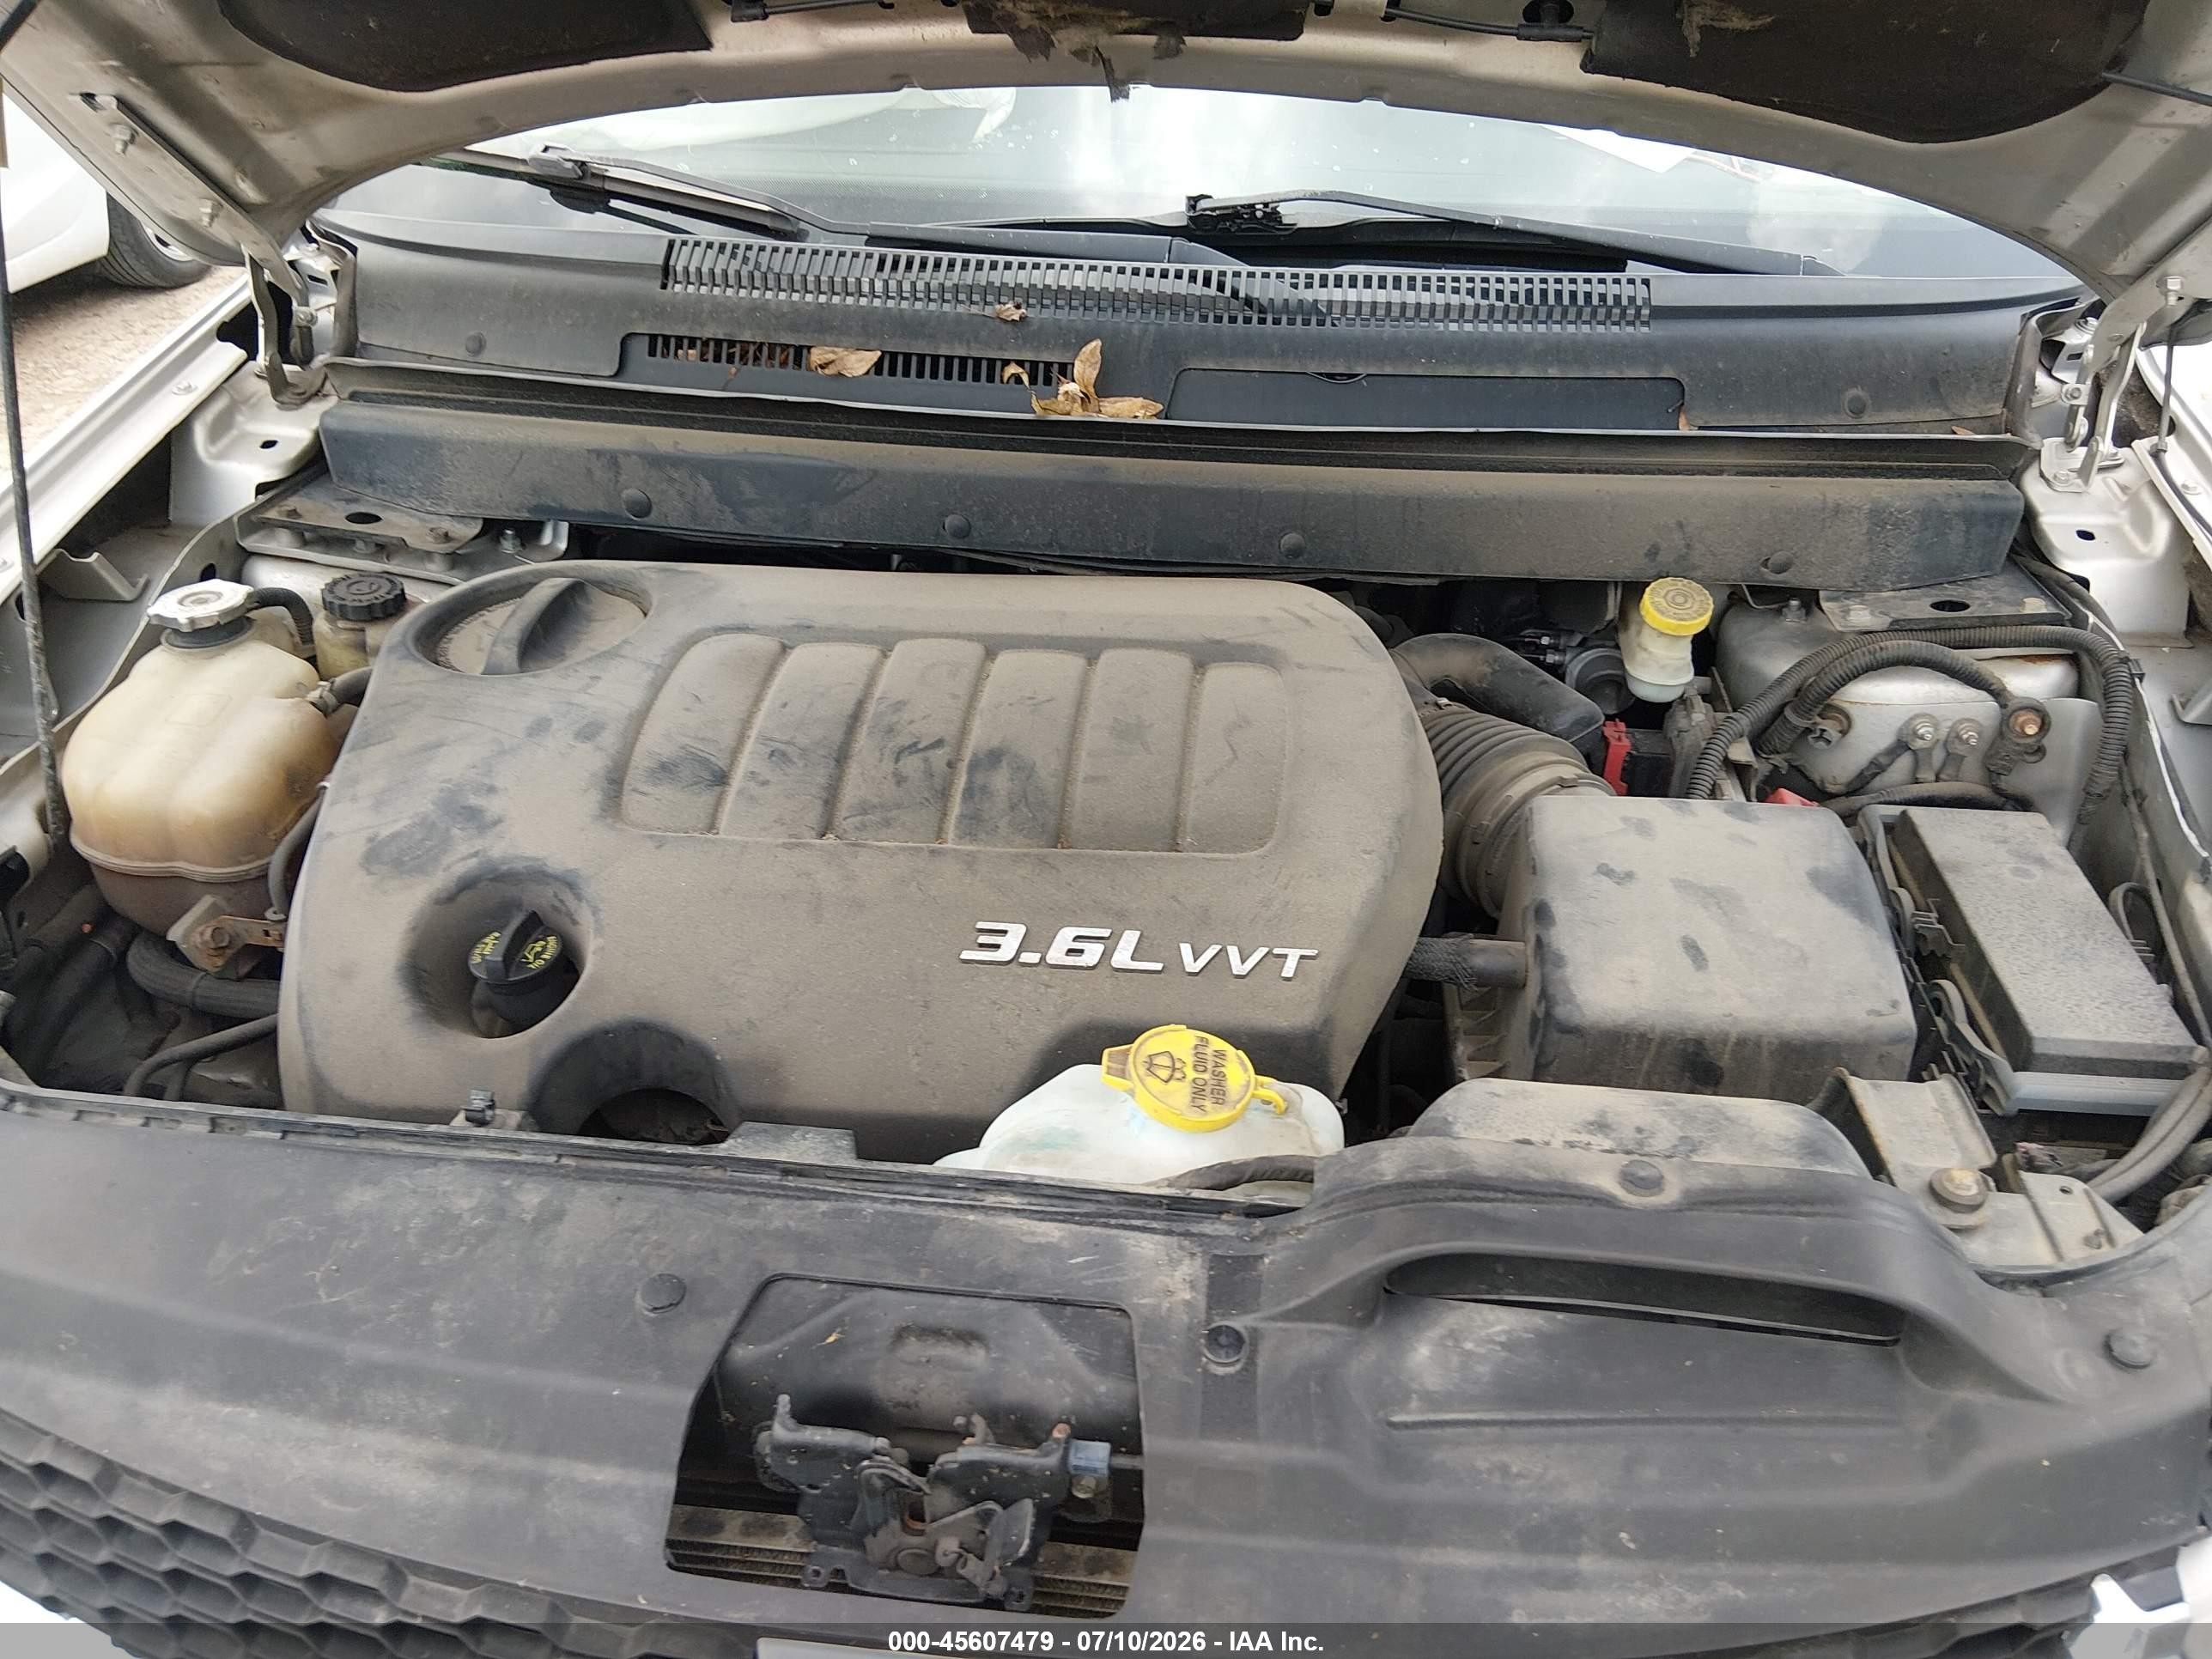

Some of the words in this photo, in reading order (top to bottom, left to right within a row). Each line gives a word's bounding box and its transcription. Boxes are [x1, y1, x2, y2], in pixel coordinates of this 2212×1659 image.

[959, 921, 1165, 974] 3.6L
[1178, 942, 1320, 981] VVT
[1192, 1035, 1210, 1072] FLUID
[1210, 1048, 1227, 1106] WASHER
[1190, 1076, 1208, 1113] ONLY
